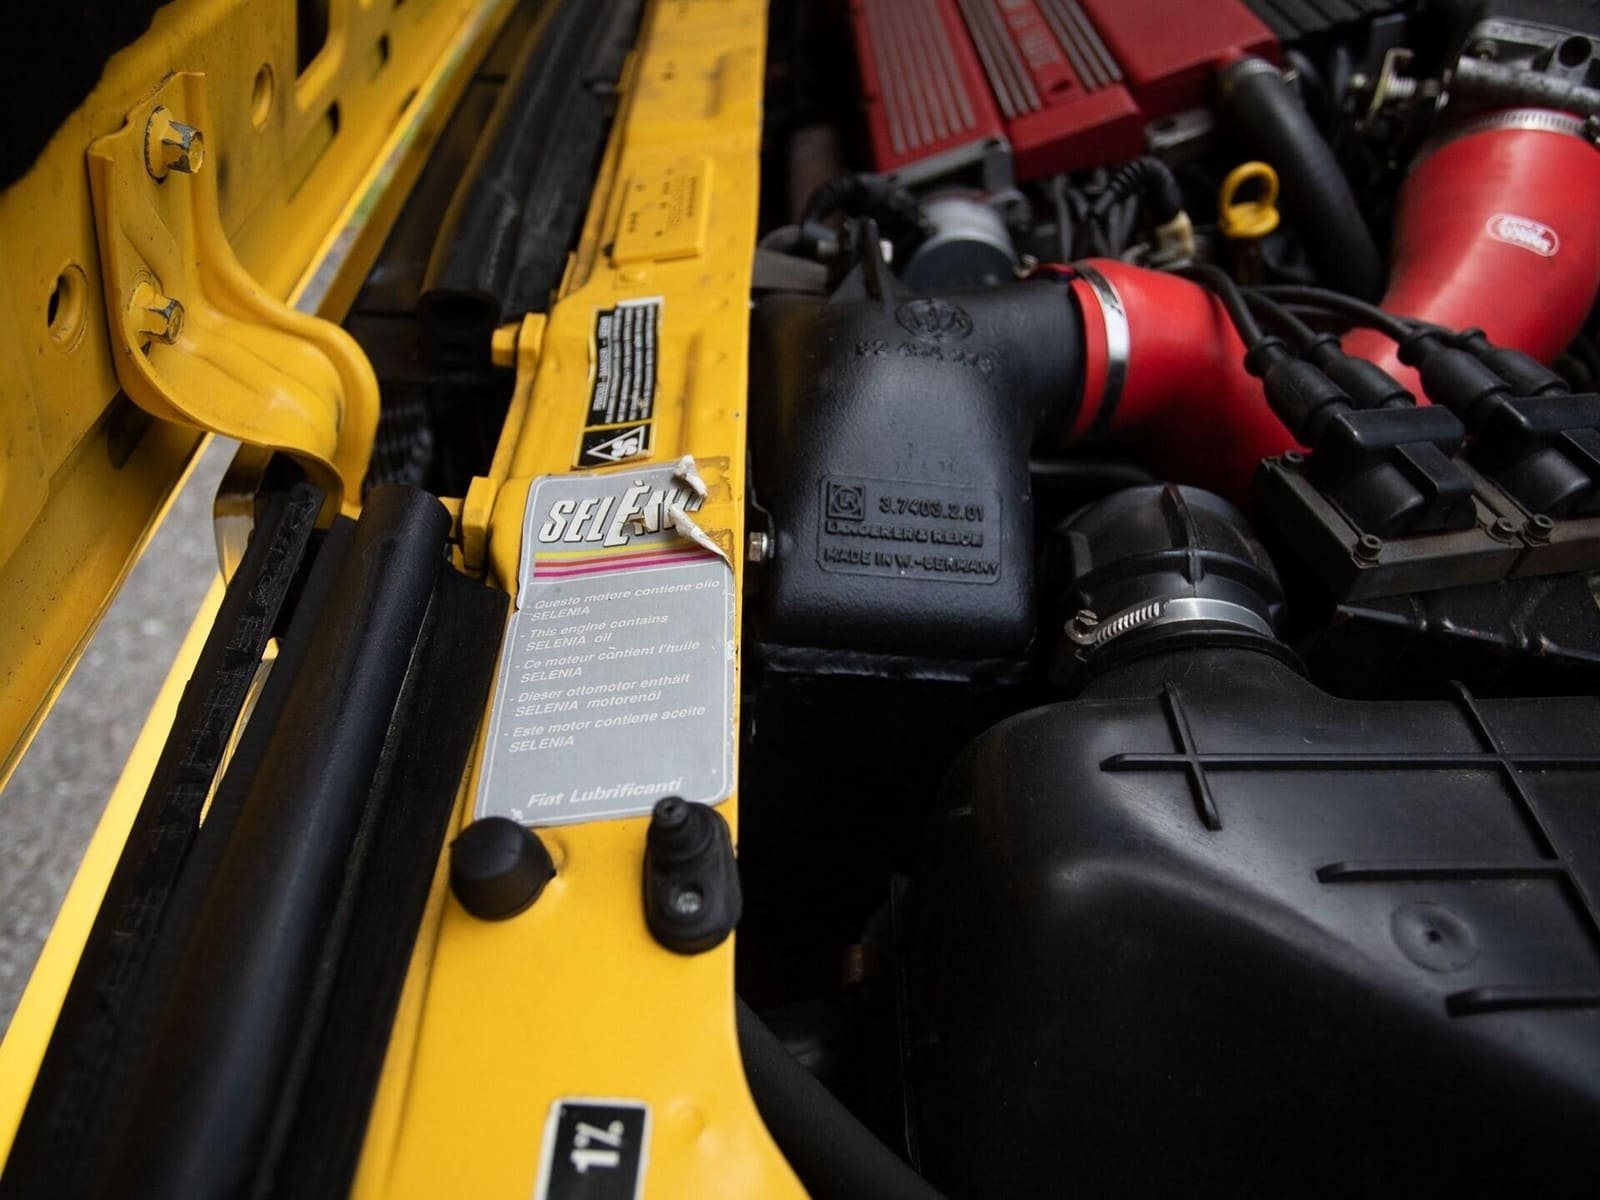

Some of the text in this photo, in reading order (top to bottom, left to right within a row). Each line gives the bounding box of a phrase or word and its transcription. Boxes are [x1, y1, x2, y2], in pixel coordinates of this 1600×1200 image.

[879, 496, 984, 523] 3.7403.2.01
[824, 548, 871, 566] MADE
[874, 552, 893, 567] IN
[535, 597, 581, 611] Questo
[584, 589, 631, 604] motore
[635, 583, 692, 598] contiene
[695, 579, 720, 590] olio
[530, 605, 590, 622] SELENIA
[530, 627, 557, 639] This
[561, 620, 606, 637] engine
[610, 613, 669, 629] contains
[527, 632, 612, 652] SELENIA oil
[523, 659, 541, 671] Ce
[545, 652, 594, 667] moteur
[598, 645, 655, 660] contient
[659, 640, 700, 653] l'huile
[520, 667, 583, 683] SELENIA
[517, 689, 563, 703] Dieser
[567, 681, 636, 698] ottomotor
[514, 701, 578, 717] SELENIA
[513, 725, 544, 738] Este
[548, 718, 592, 733] motor
[595, 712, 658, 729] contiene
[661, 705, 706, 721] aceite
[509, 735, 575, 753] SELENIA
[526, 776, 684, 808] Fiat Lubrificanti
